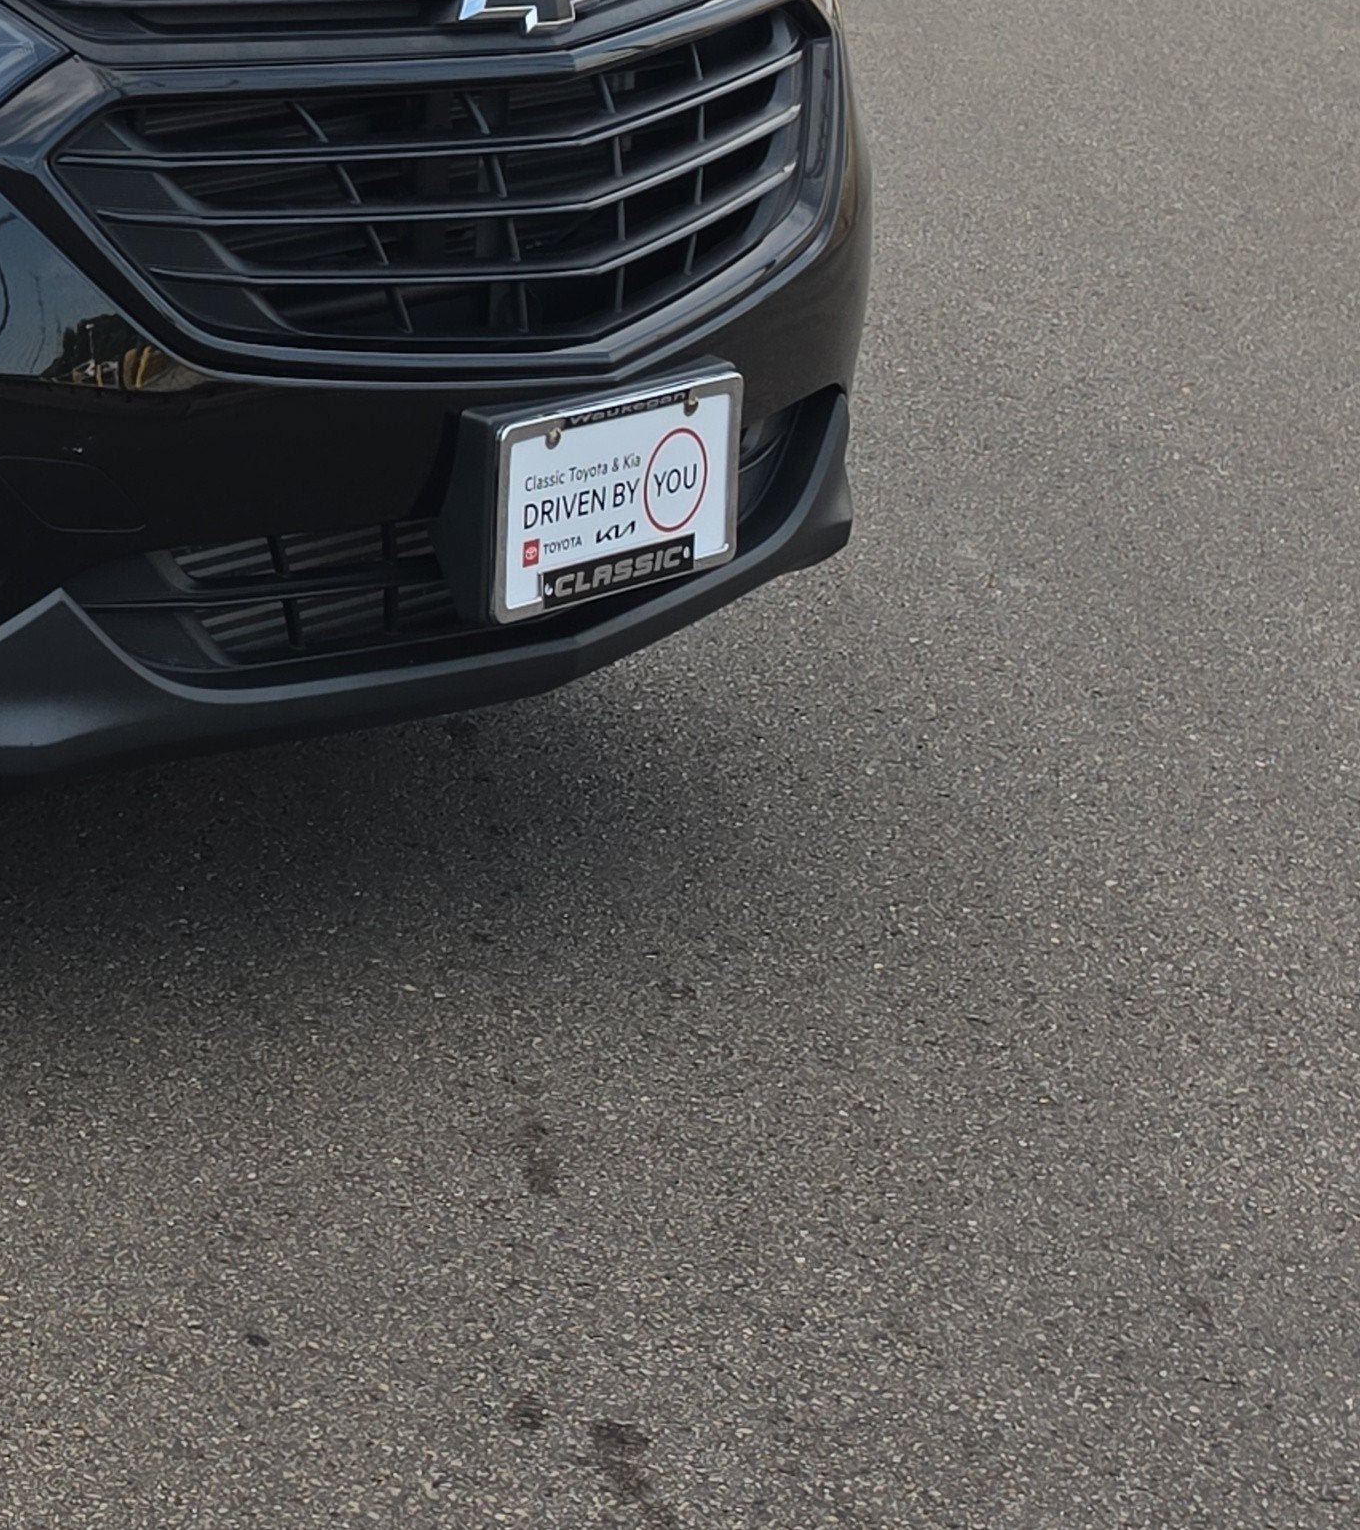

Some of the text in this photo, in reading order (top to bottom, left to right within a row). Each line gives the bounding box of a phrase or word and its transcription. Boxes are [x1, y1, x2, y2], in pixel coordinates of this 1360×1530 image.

[568, 391, 687, 425] Waukegan
[525, 453, 641, 492] Classic Toyota & Kia
[523, 463, 697, 530] DRIVEN BY YOU
[543, 536, 583, 554] TOYOTA
[554, 546, 682, 598] CLASSIC
